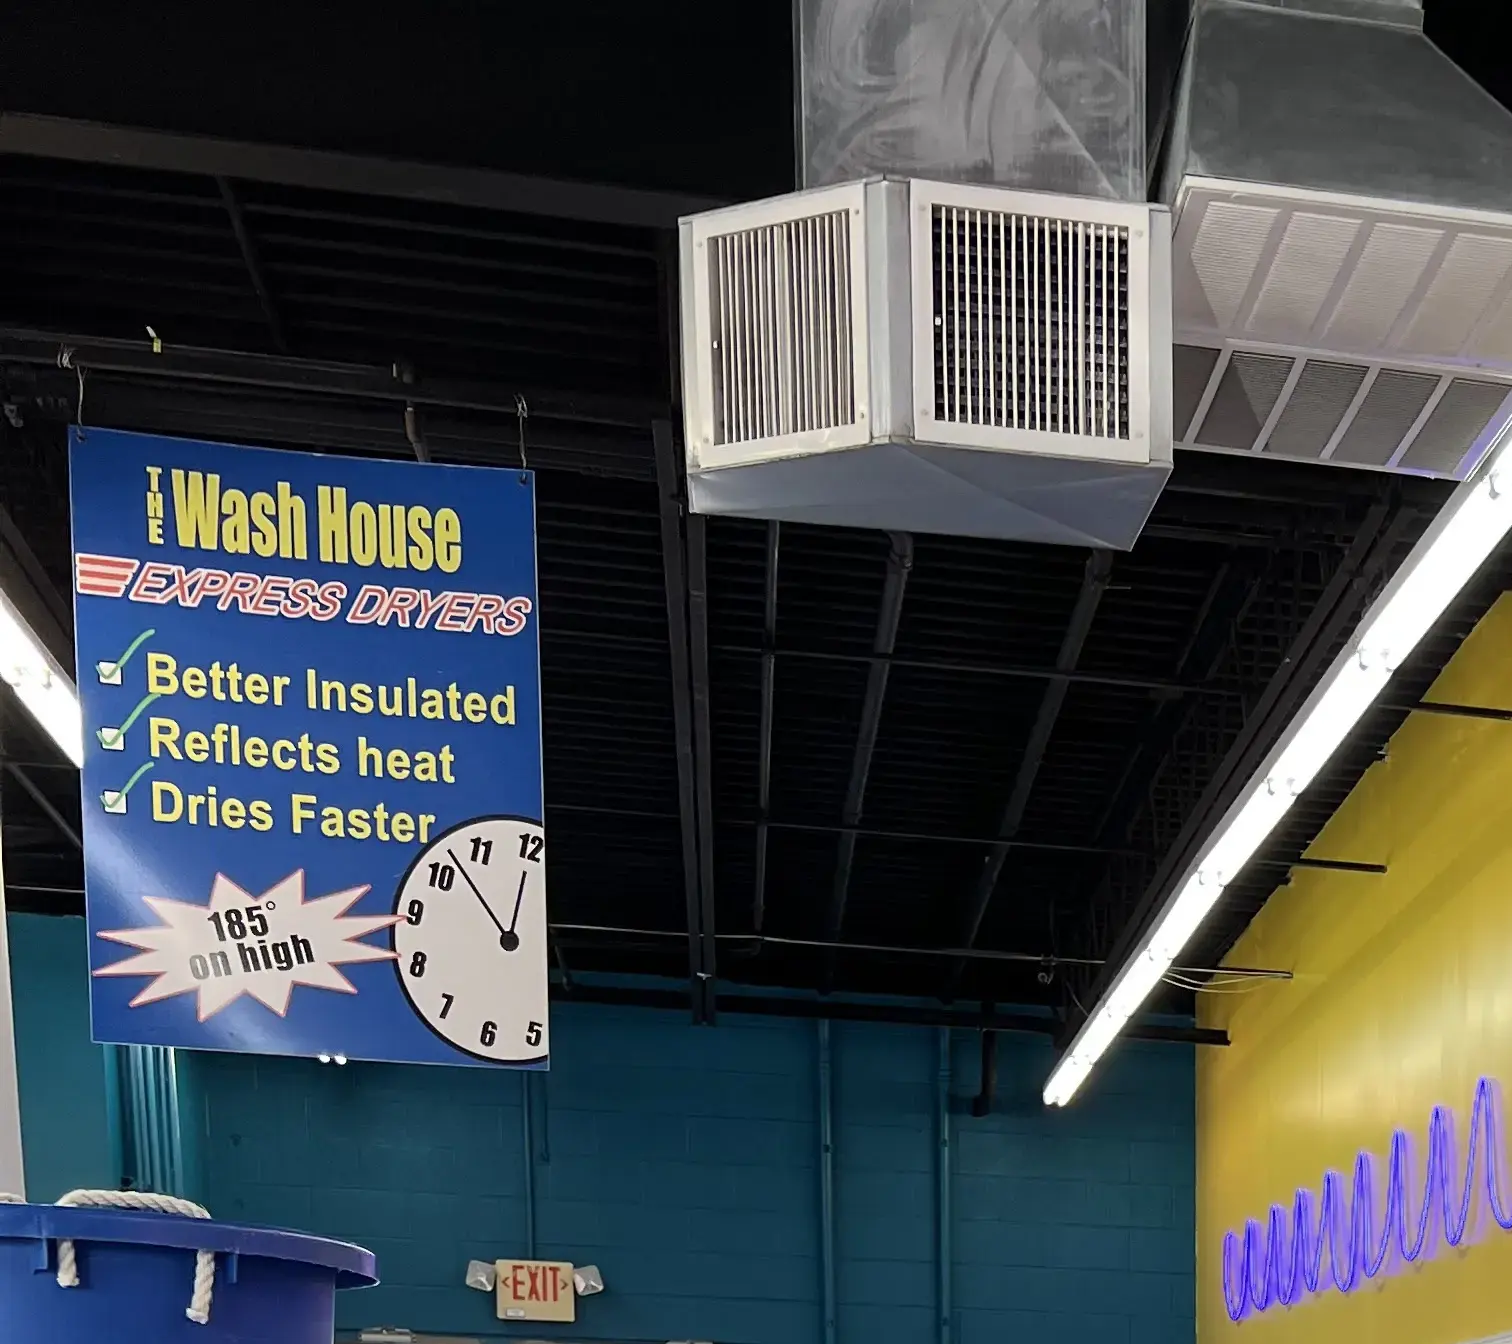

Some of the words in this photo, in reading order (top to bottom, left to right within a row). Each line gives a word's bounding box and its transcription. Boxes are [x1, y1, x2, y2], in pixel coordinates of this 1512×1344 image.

[146, 466, 164, 545] THE
[171, 468, 307, 560] Wash
[317, 484, 461, 573] House
[129, 562, 347, 621] EXPRESS
[347, 583, 532, 636] DRYERS
[147, 652, 290, 706] Better
[306, 668, 516, 726] Insulated
[149, 716, 341, 774] Reflects
[357, 736, 456, 783] heat
[152, 780, 274, 832] Dries
[291, 793, 436, 843] Faster
[470, 836, 493, 866] 11
[519, 833, 544, 863] 12
[428, 861, 455, 892] 10
[407, 899, 424, 926] 9
[189, 950, 232, 980] on
[236, 934, 315, 971] high
[410, 951, 427, 978] 8
[439, 993, 454, 1019] 7
[480, 1020, 497, 1047] 6
[526, 1021, 543, 1047] 5
[512, 1264, 561, 1302] EXIT
